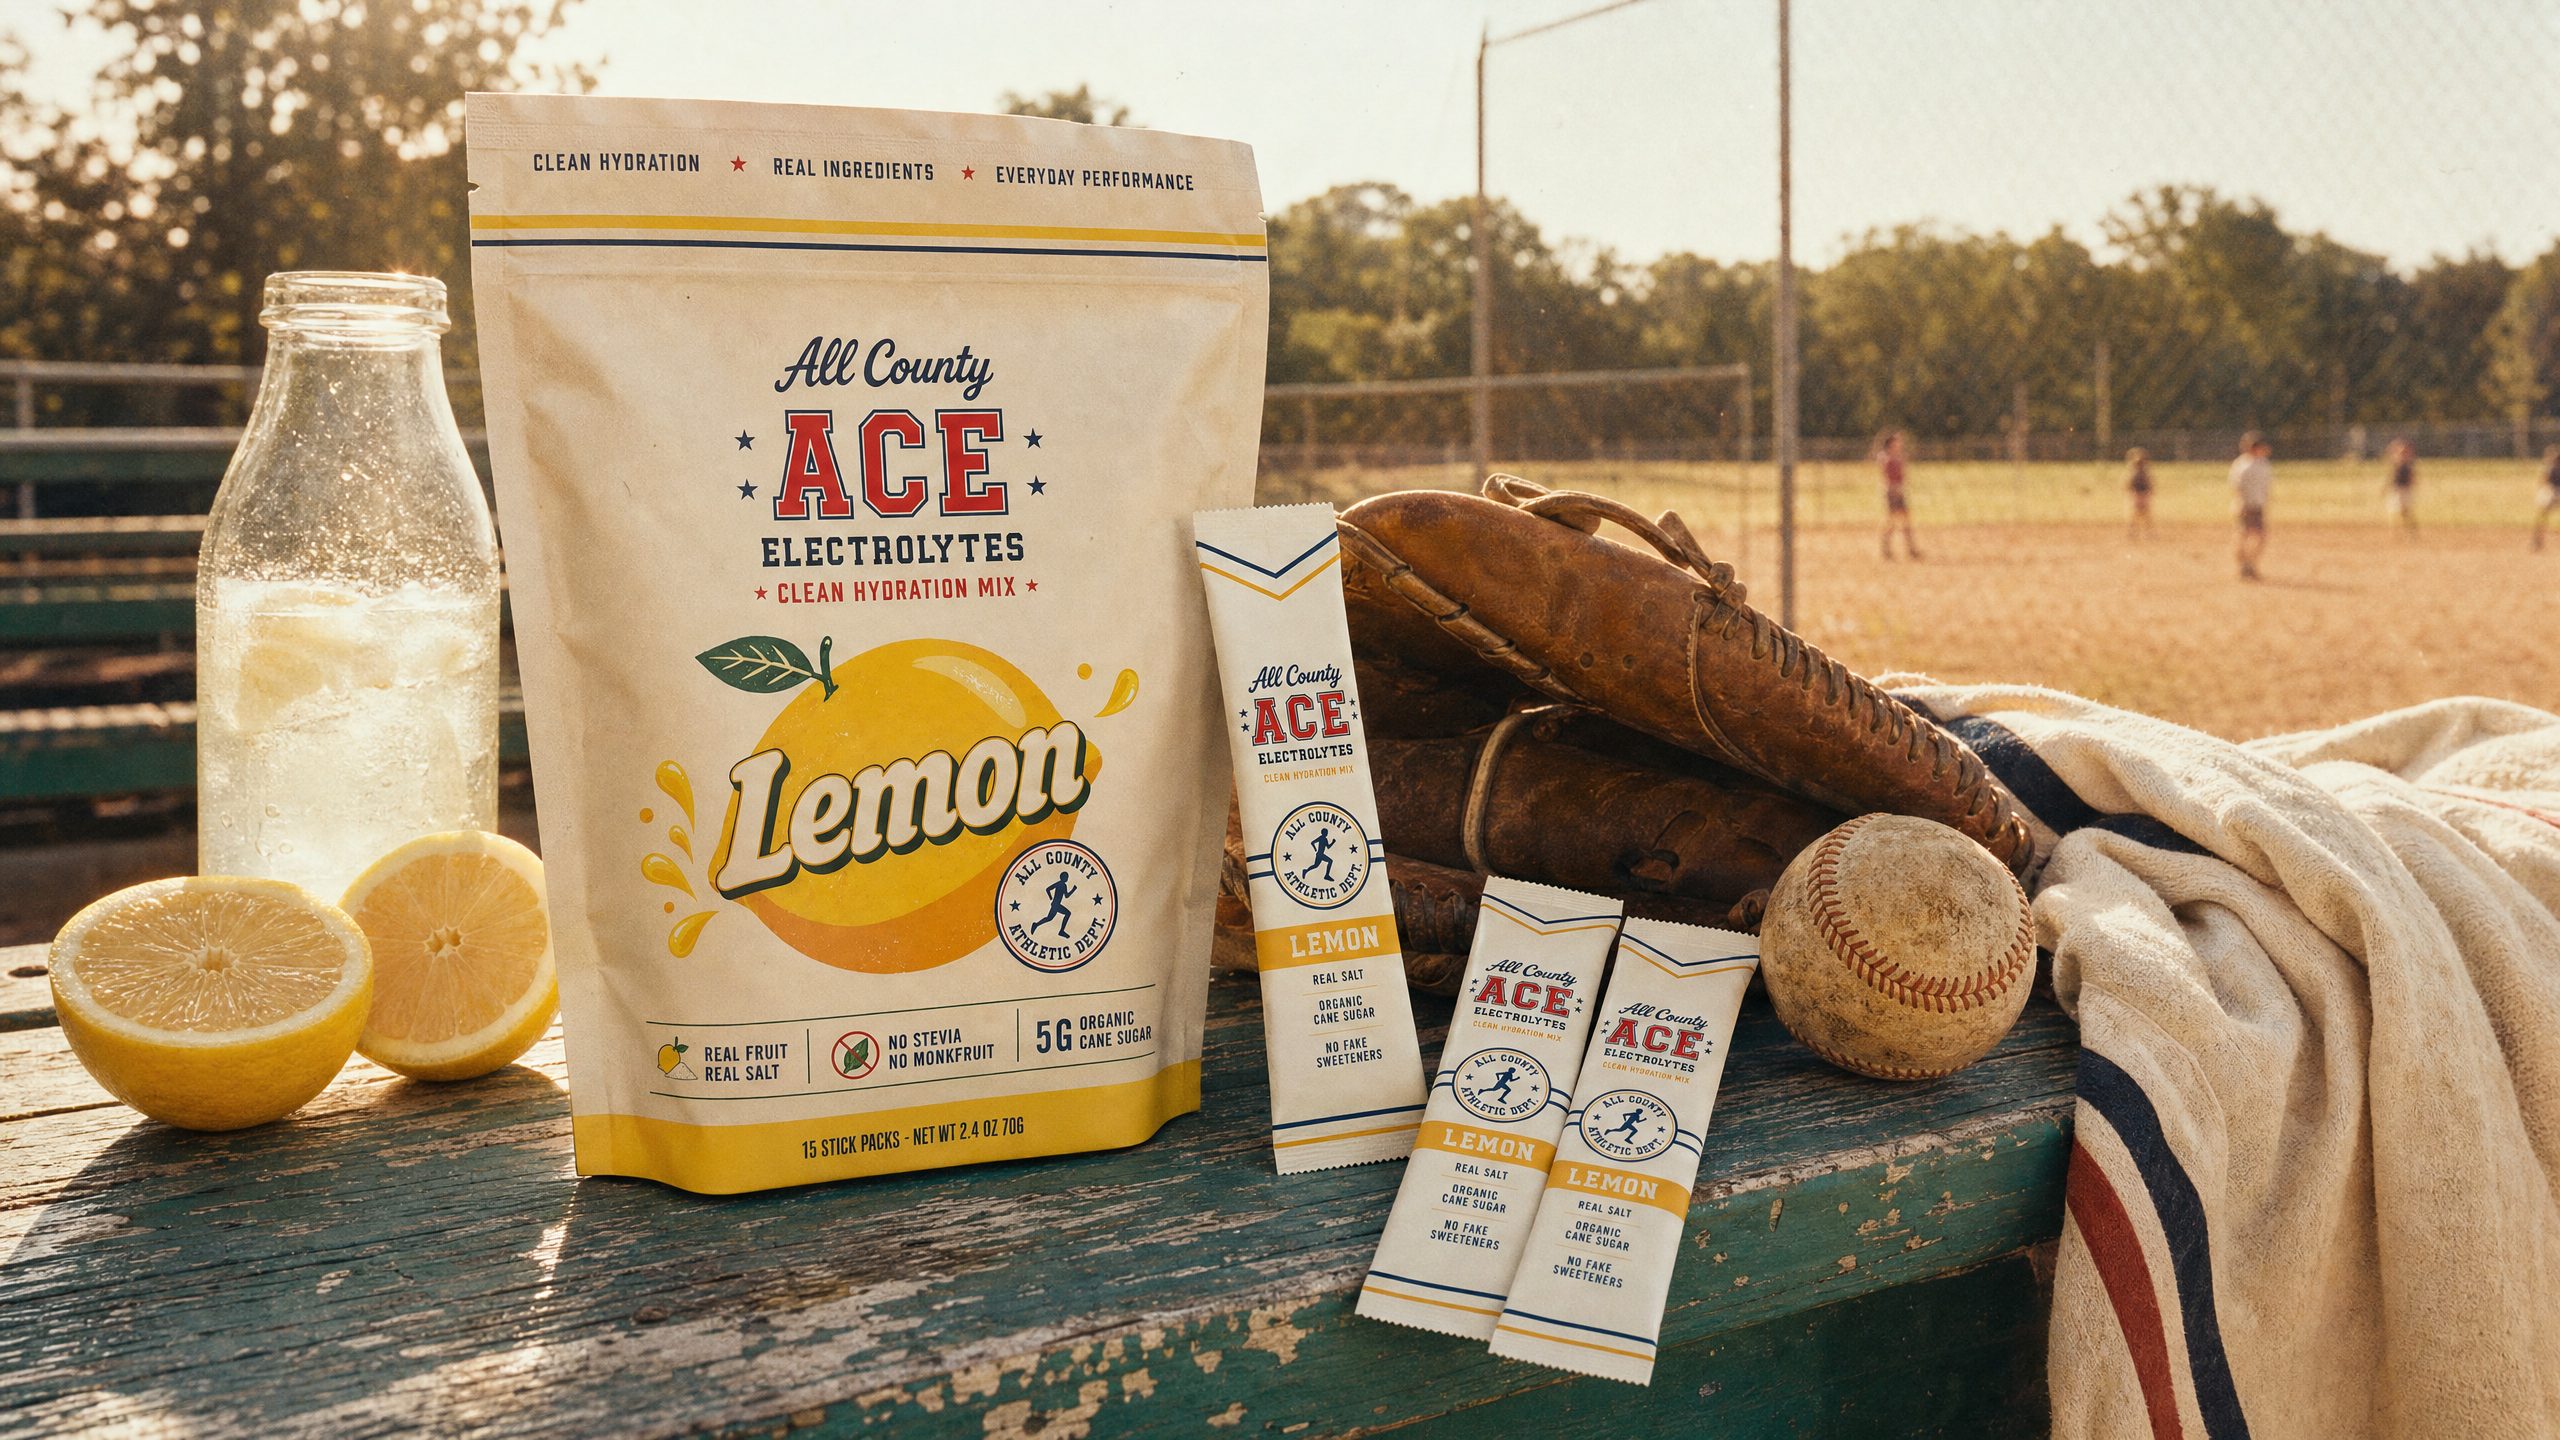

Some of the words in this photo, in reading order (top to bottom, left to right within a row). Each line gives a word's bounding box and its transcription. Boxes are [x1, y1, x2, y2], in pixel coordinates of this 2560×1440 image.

[533, 154, 591, 172] CLEAN
[599, 153, 700, 173] HYDRATION
[773, 158, 816, 177] REAL
[823, 159, 935, 181] INGREDIENTS
[996, 166, 1076, 186] EVERYDAY
[1082, 168, 1195, 190] PERFORMANCE
[775, 336, 858, 393] All
[864, 338, 994, 400] County
[773, 408, 1009, 521] ACE
[762, 532, 1024, 568] ELECTROLYTES
[778, 582, 844, 604] CLEAN
[854, 578, 967, 601] HYDRATION
[978, 576, 1016, 598] MIX
[1249, 666, 1283, 693] All
[1287, 664, 1342, 688] County
[1252, 690, 1350, 746] ACE
[1258, 744, 1353, 765] ELECTROLYTES
[1264, 773, 1290, 783] CLEAN
[1294, 768, 1336, 780] HYDRATION
[1340, 765, 1354, 774] MIX
[716, 720, 1091, 901] Lemon
[1285, 818, 1306, 841] ALL
[1309, 812, 1351, 834] COUNTY
[1016, 856, 1042, 886] ALL
[1046, 852, 1099, 881] COUNTY
[1284, 870, 1338, 900] ATHLETIC
[1339, 863, 1363, 893] DEPT.
[1008, 923, 1071, 961] ATHLETIC
[1075, 917, 1106, 959] DEPT.
[1290, 925, 1380, 958] LEMON
[1313, 972, 1338, 985] REAL
[1342, 969, 1363, 982] SALT
[1486, 959, 1523, 976] All
[1523, 964, 1577, 986] County
[1319, 995, 1363, 1011] ORGANIC
[1474, 975, 1574, 1018] ACE
[1080, 1011, 1135, 1030] ORGANIC
[1314, 1011, 1340, 1025] CANE
[1343, 1007, 1375, 1021] SUGAR
[1474, 1007, 1567, 1031] ELECTROLYTES
[1617, 1002, 1655, 1019] All
[1655, 1007, 1709, 1030] County
[888, 1033, 909, 1049] NO
[914, 1029, 962, 1047] STEVIA
[1036, 1018, 1073, 1054] 5G
[1080, 1031, 1114, 1051] CANE
[1118, 1026, 1152, 1046] SUGAR
[1326, 1041, 1340, 1053] NO
[1343, 1037, 1367, 1051] FAKE
[1605, 1017, 1705, 1061] ACE
[705, 1045, 739, 1061] REAL
[744, 1043, 788, 1060] FRUIT
[889, 1052, 909, 1069] NO
[914, 1045, 995, 1068] MONKFRUIT
[1317, 1049, 1382, 1068] SWEETENERS
[1604, 1048, 1695, 1073] ELECTROLYTES
[705, 1065, 742, 1082] REAL
[747, 1064, 779, 1081] SALT
[1474, 1054, 1496, 1068] ALL
[1501, 1054, 1539, 1076] COUNTY
[1675, 1075, 1690, 1083] MIX
[1461, 1087, 1505, 1115] ATHLETIC
[1510, 1098, 1539, 1115] DEPT.
[1602, 1095, 1624, 1108] ALL
[1629, 1095, 1667, 1118] COUNTY
[802, 1140, 817, 1158] 15
[821, 1138, 857, 1158] STICK
[861, 1133, 900, 1153] PACKS
[913, 1127, 935, 1147] NET
[938, 1124, 957, 1144] WT
[960, 1122, 980, 1141] 2.4
[983, 1119, 998, 1138] OZ
[1002, 1116, 1024, 1137] 70G
[1443, 1128, 1536, 1162] LEMON
[1588, 1126, 1631, 1155] ATHLETIC
[1636, 1138, 1664, 1154] DEPT.
[1455, 1163, 1480, 1176] REAL
[1482, 1169, 1508, 1180] SALT
[1452, 1185, 1499, 1200] ORGANIC
[1567, 1168, 1658, 1200] LEMON
[1442, 1194, 1470, 1207] CANE
[1473, 1200, 1506, 1214] SUGAR
[1578, 1200, 1603, 1214] REAL
[1606, 1206, 1632, 1218] SALT
[1444, 1220, 1459, 1231] NO
[1463, 1223, 1489, 1235] FAKE
[1576, 1221, 1622, 1238] ORGANIC
[1430, 1230, 1500, 1250] SWEETENERS
[1565, 1230, 1594, 1245] CANE
[1595, 1237, 1630, 1251] SUGAR
[1553, 1264, 1623, 1288] SWEETENERS
[1567, 1256, 1583, 1267] NO
[1586, 1259, 1612, 1273] FAKE
